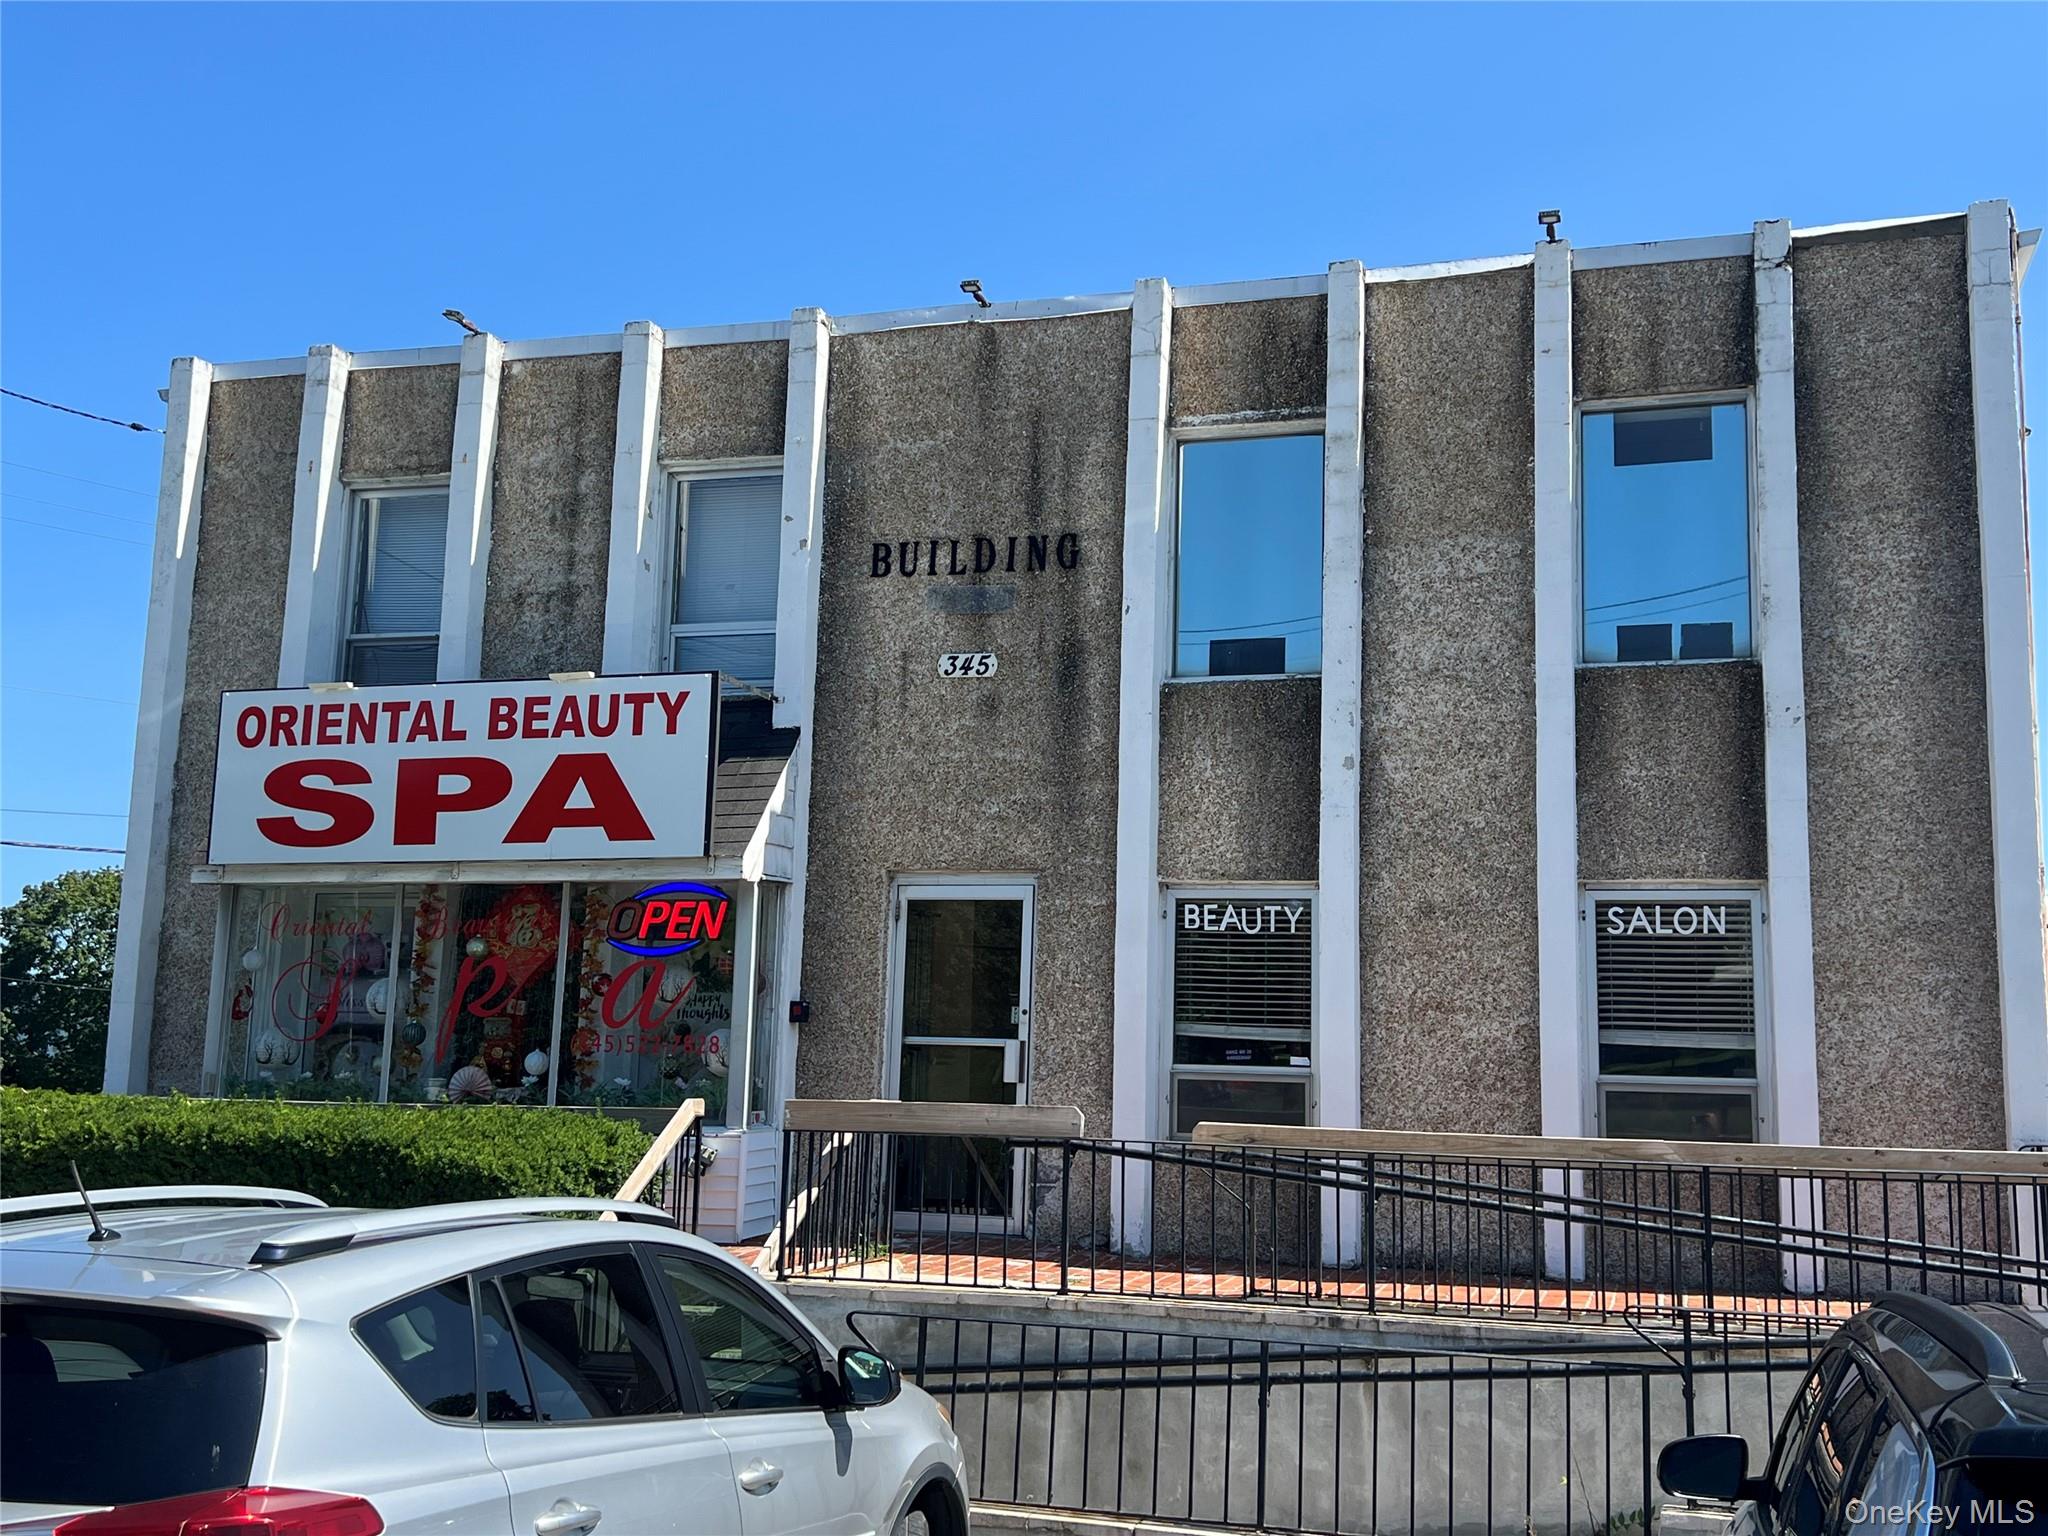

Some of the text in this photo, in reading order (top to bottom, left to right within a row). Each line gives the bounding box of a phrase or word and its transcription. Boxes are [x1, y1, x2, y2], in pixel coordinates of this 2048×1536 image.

[869, 533, 1080, 577] BUILDING
[943, 654, 992, 676] 345
[236, 690, 691, 749] ORIENTAL BEAUTY
[255, 752, 656, 848] SPA
[607, 900, 729, 940] OPEN
[1184, 904, 1303, 934] BEAUTY
[1606, 905, 1726, 935] SALON
